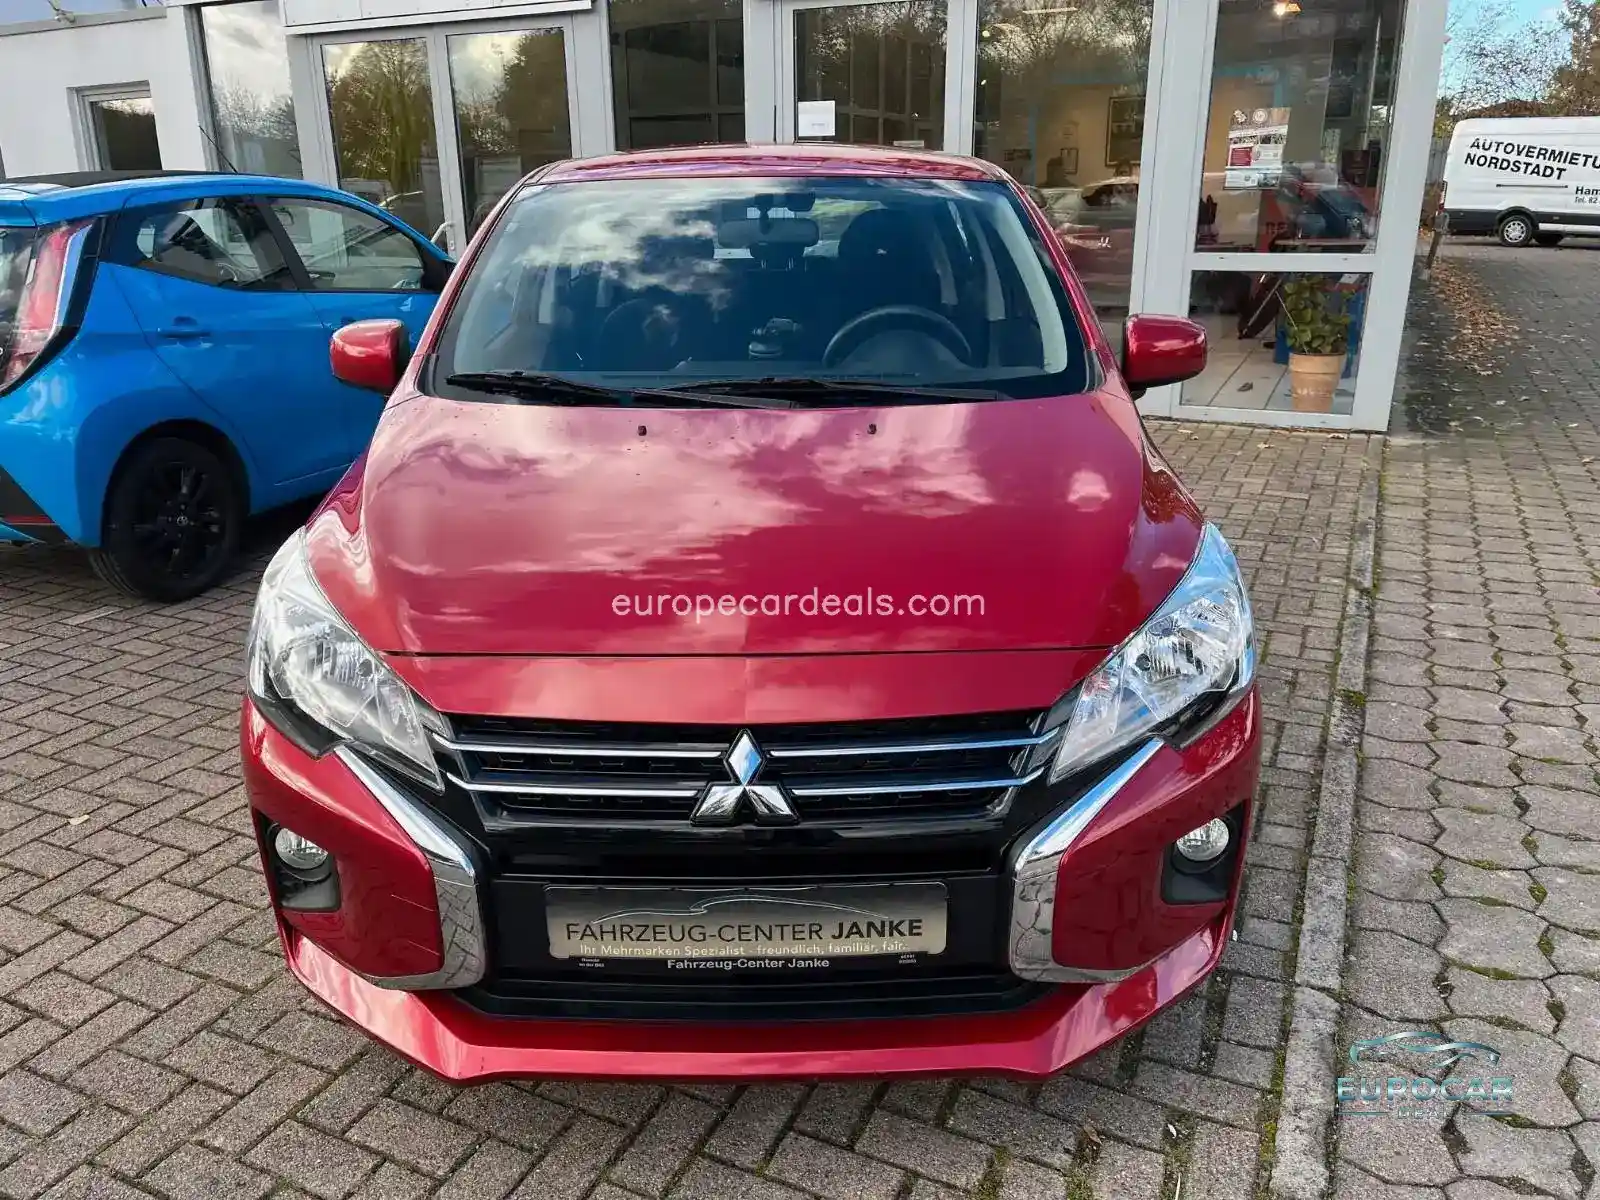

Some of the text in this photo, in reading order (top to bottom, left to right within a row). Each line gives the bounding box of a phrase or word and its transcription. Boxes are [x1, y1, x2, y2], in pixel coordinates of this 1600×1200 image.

[1464, 152, 1567, 180] NORDSTADT
[566, 918, 923, 942] FAHRZEUG-CENTER JANKE
[580, 944, 596, 955] Ihr
[601, 945, 680, 956] Mehrmarken
[685, 945, 745, 958] Spezialist
[757, 944, 825, 956] freundlich,
[667, 959, 830, 971] Fahrzeug-Center Janke
